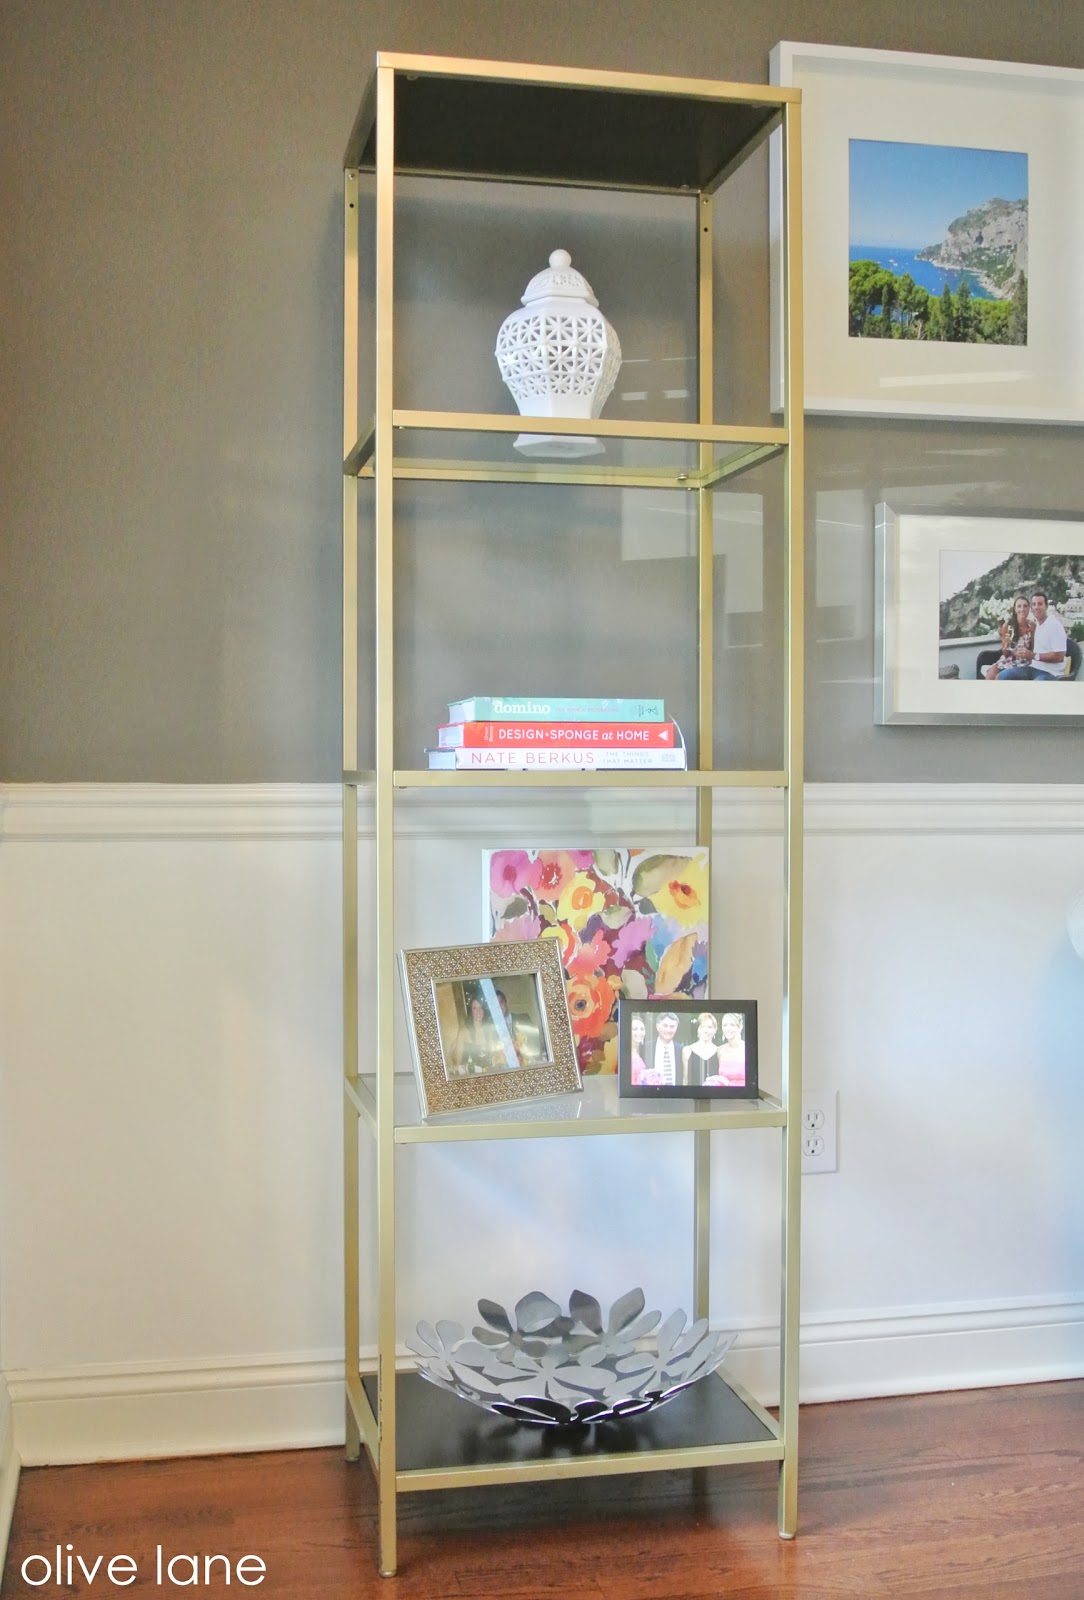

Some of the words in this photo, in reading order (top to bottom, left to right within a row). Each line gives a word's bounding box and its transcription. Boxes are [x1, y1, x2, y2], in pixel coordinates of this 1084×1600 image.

[494, 700, 552, 714] domino
[601, 730, 614, 740] at
[616, 730, 650, 741] HOME
[471, 752, 517, 764] NATE
[525, 752, 594, 764] BERKUS
